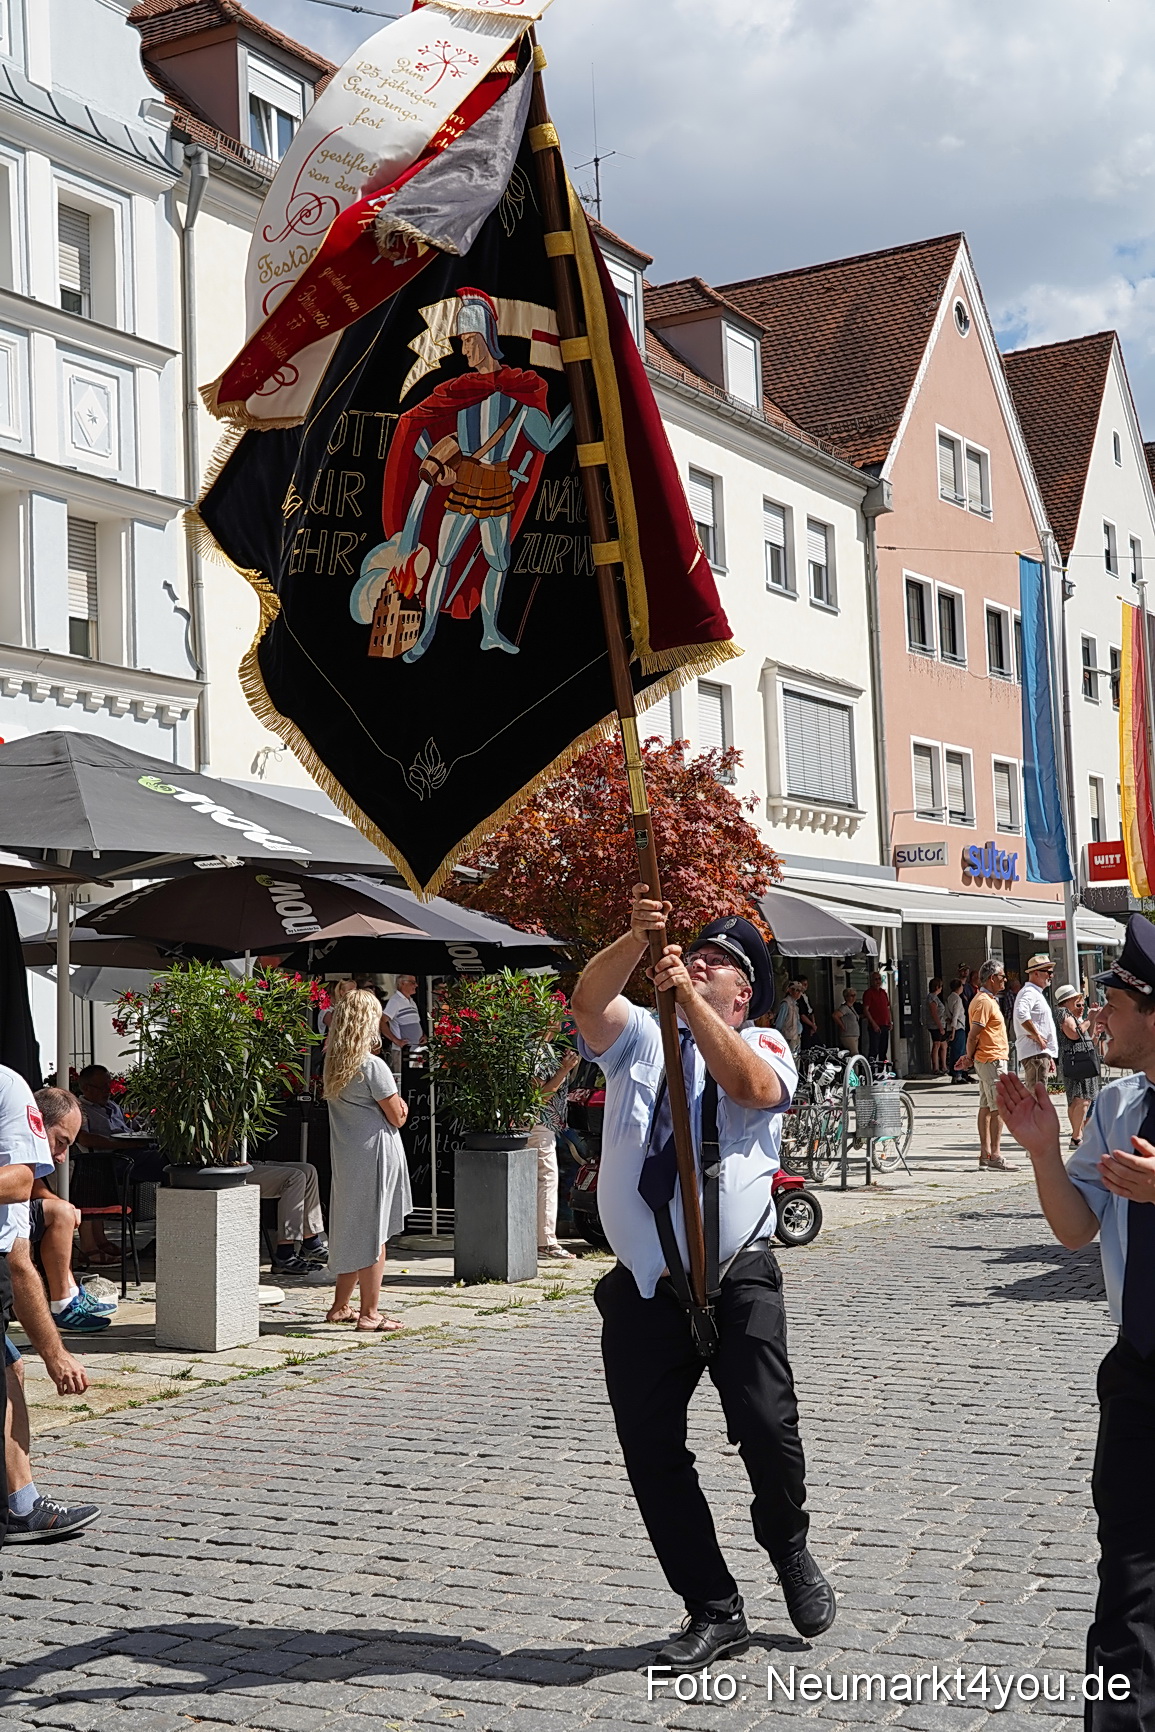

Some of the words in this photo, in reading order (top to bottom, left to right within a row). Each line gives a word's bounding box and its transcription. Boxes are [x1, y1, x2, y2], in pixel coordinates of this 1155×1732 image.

[392, 58, 424, 81] Zum
[356, 61, 437, 108] 125-jährigen
[343, 76, 423, 121] Gründungs-
[349, 108, 385, 129] fest
[317, 150, 378, 176] gestiftet
[308, 168, 330, 184] von
[335, 176, 358, 195] den
[1094, 854, 1121, 865] WITT
